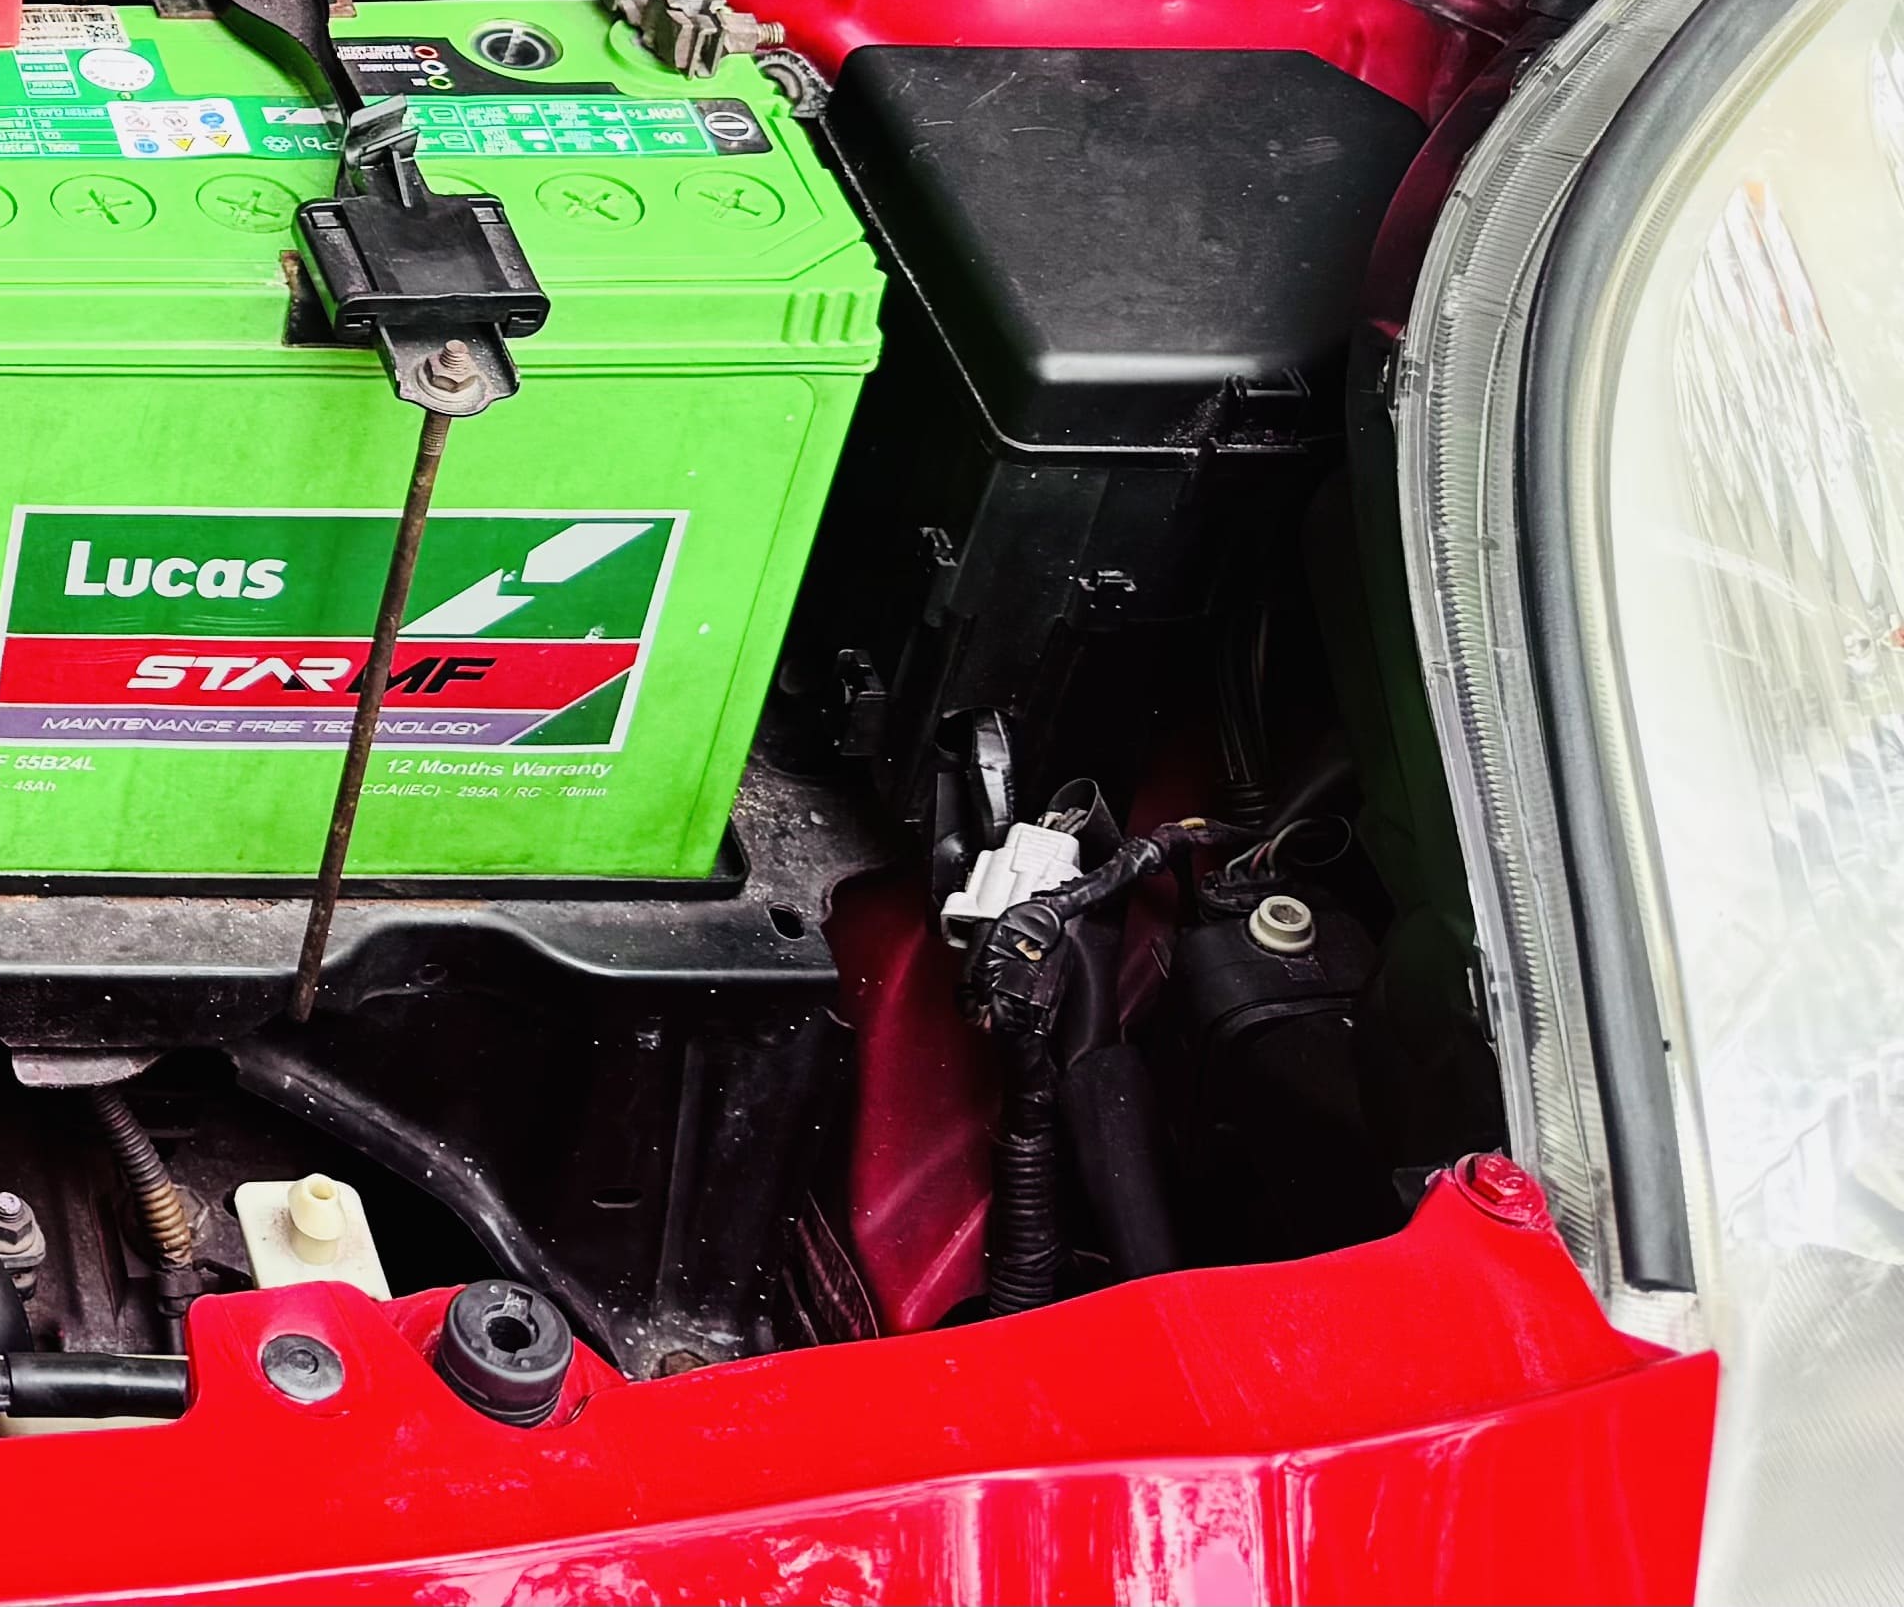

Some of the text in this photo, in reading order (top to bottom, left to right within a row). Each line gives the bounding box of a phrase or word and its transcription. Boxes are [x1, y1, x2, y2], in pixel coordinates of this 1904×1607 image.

[64, 540, 288, 599] Lucas
[41, 717, 492, 735] MAINTENANCE FREE TECNOLOGY
[14, 755, 96, 771] 55B24L
[387, 759, 613, 779] 12 Months Warranty
[13, 780, 56, 792] 45Ah
[360, 784, 441, 796] CCA(IEC)
[457, 786, 498, 798] 295A
[514, 787, 542, 798] RC
[558, 786, 607, 798] 70min
